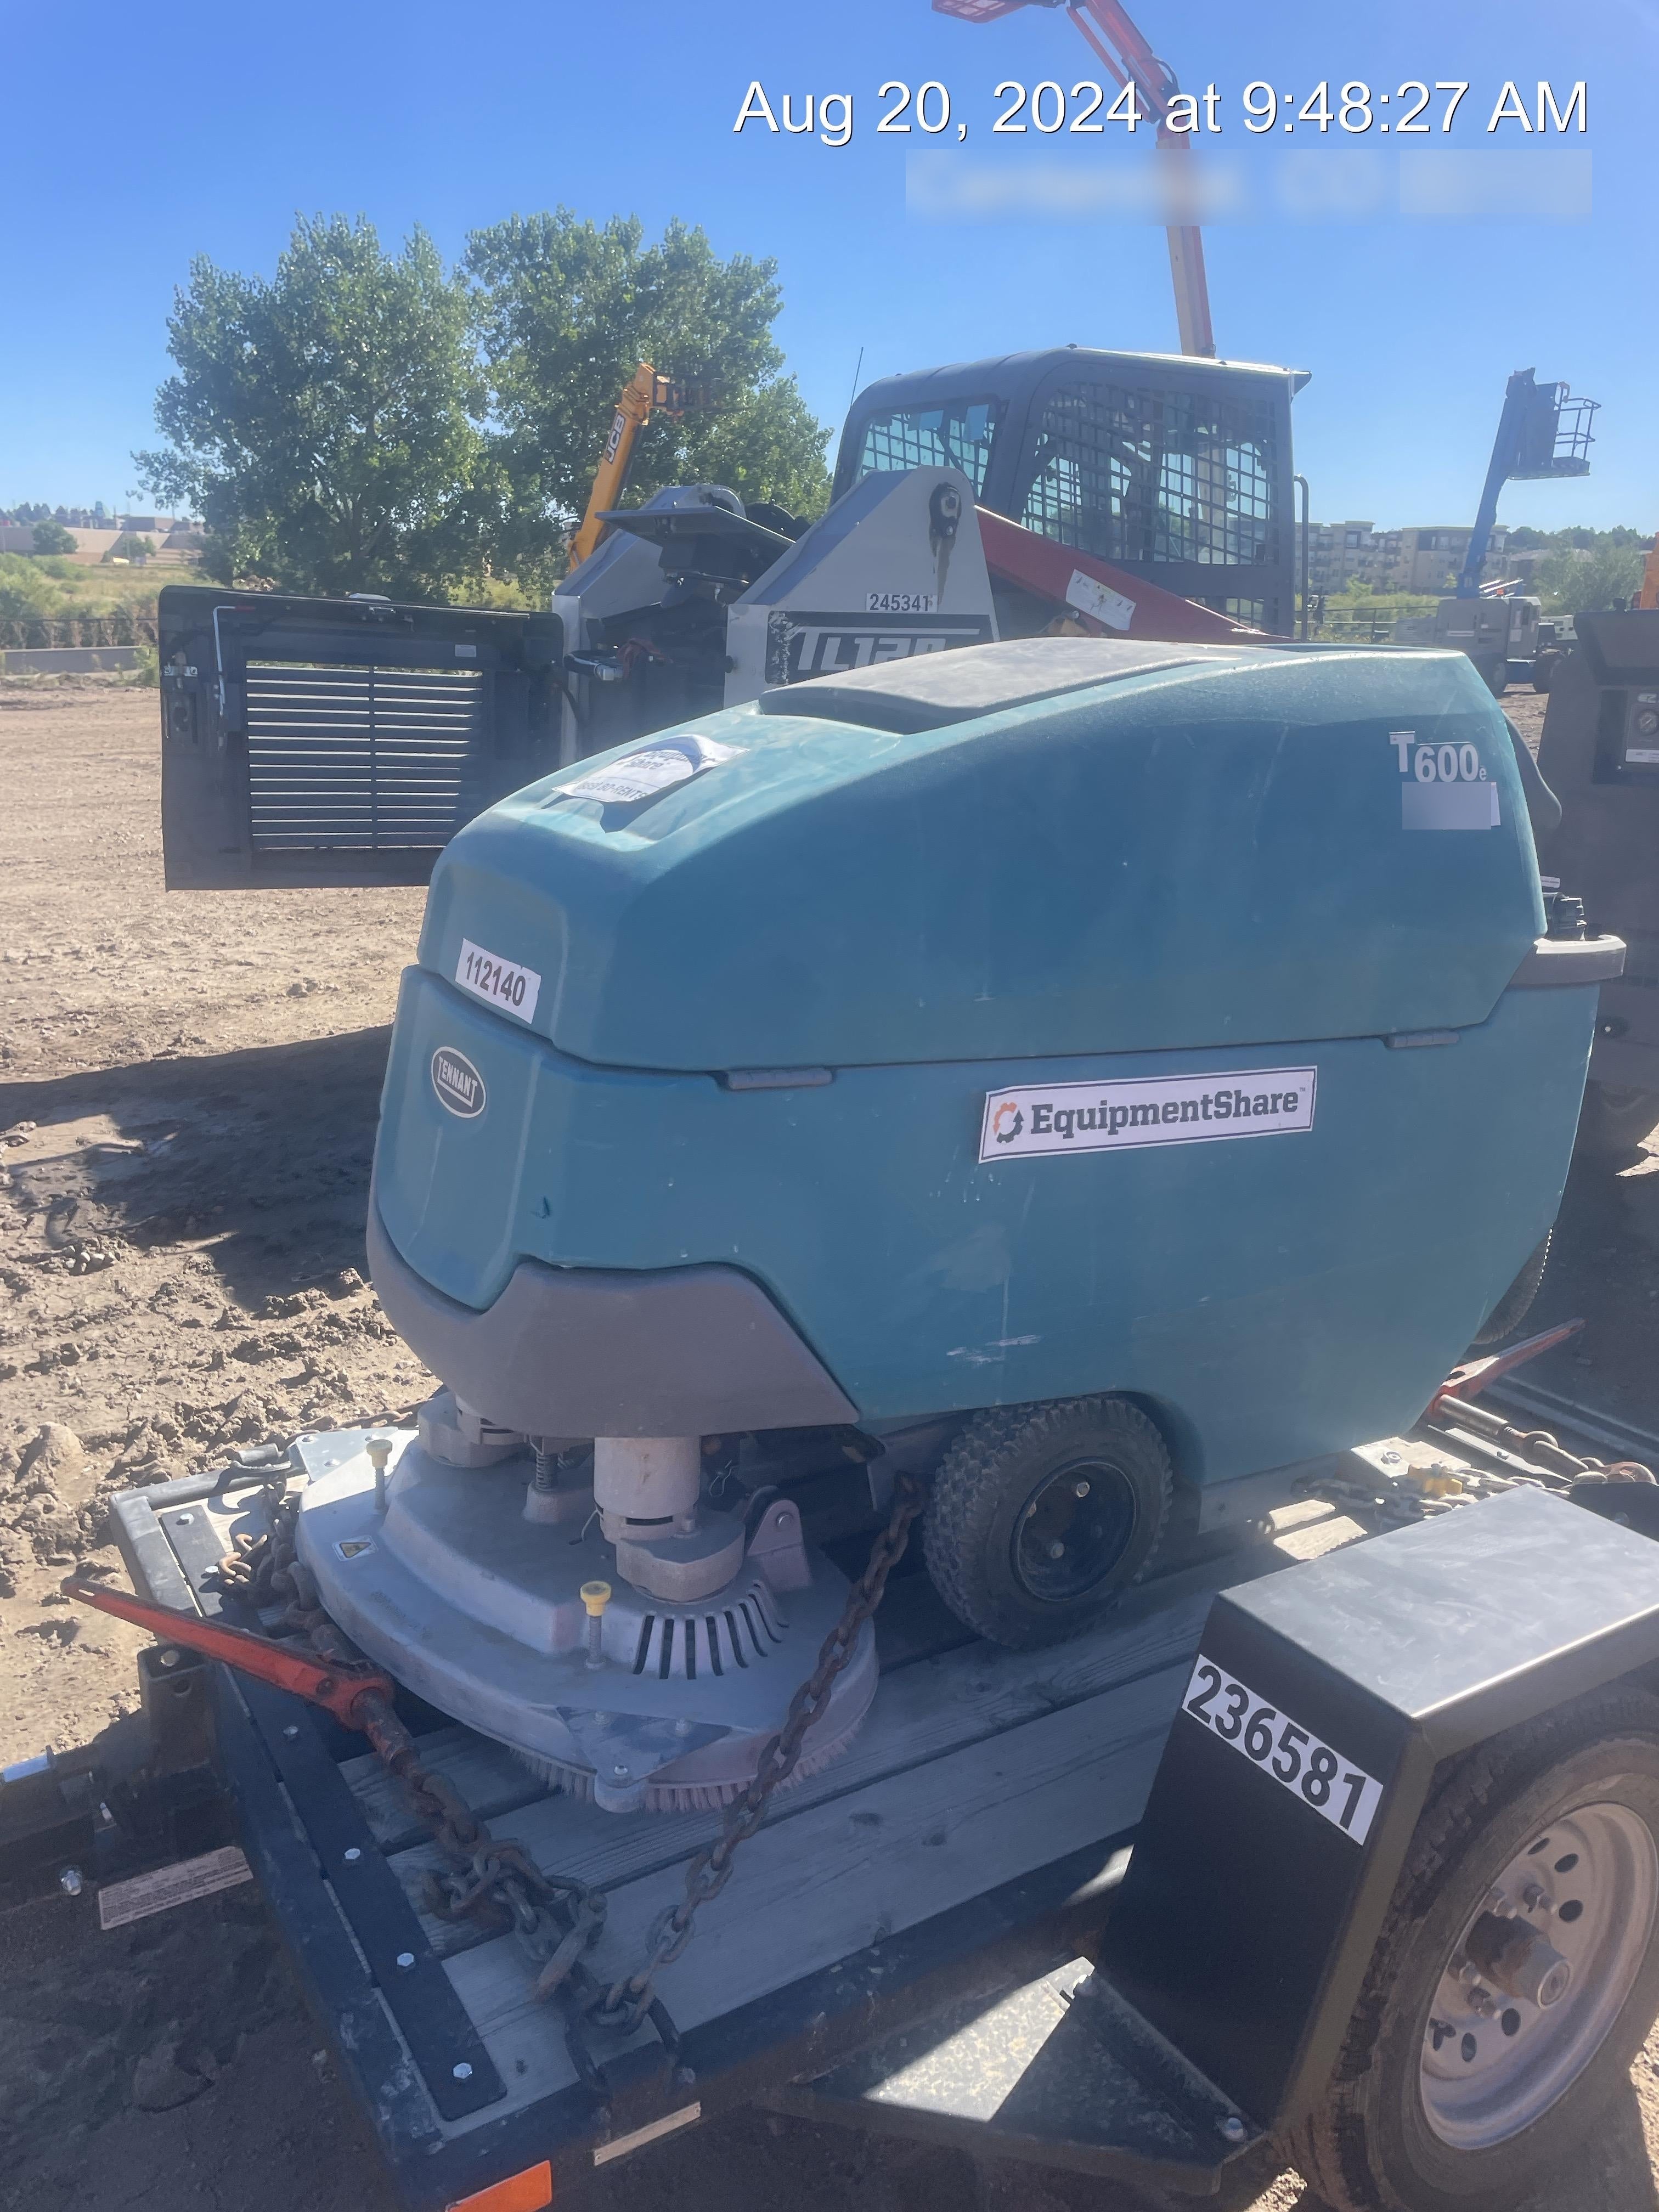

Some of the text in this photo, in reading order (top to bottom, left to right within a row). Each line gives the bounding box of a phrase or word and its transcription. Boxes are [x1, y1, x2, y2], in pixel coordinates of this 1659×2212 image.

[606, 414, 625, 464] JCB
[870, 593, 929, 612] 245341
[466, 951, 526, 1007] 112140
[437, 1056, 478, 1107] TENNANT
[1030, 1089, 1299, 1139] EquipmentShare
[1187, 1664, 1367, 1831] 236581
